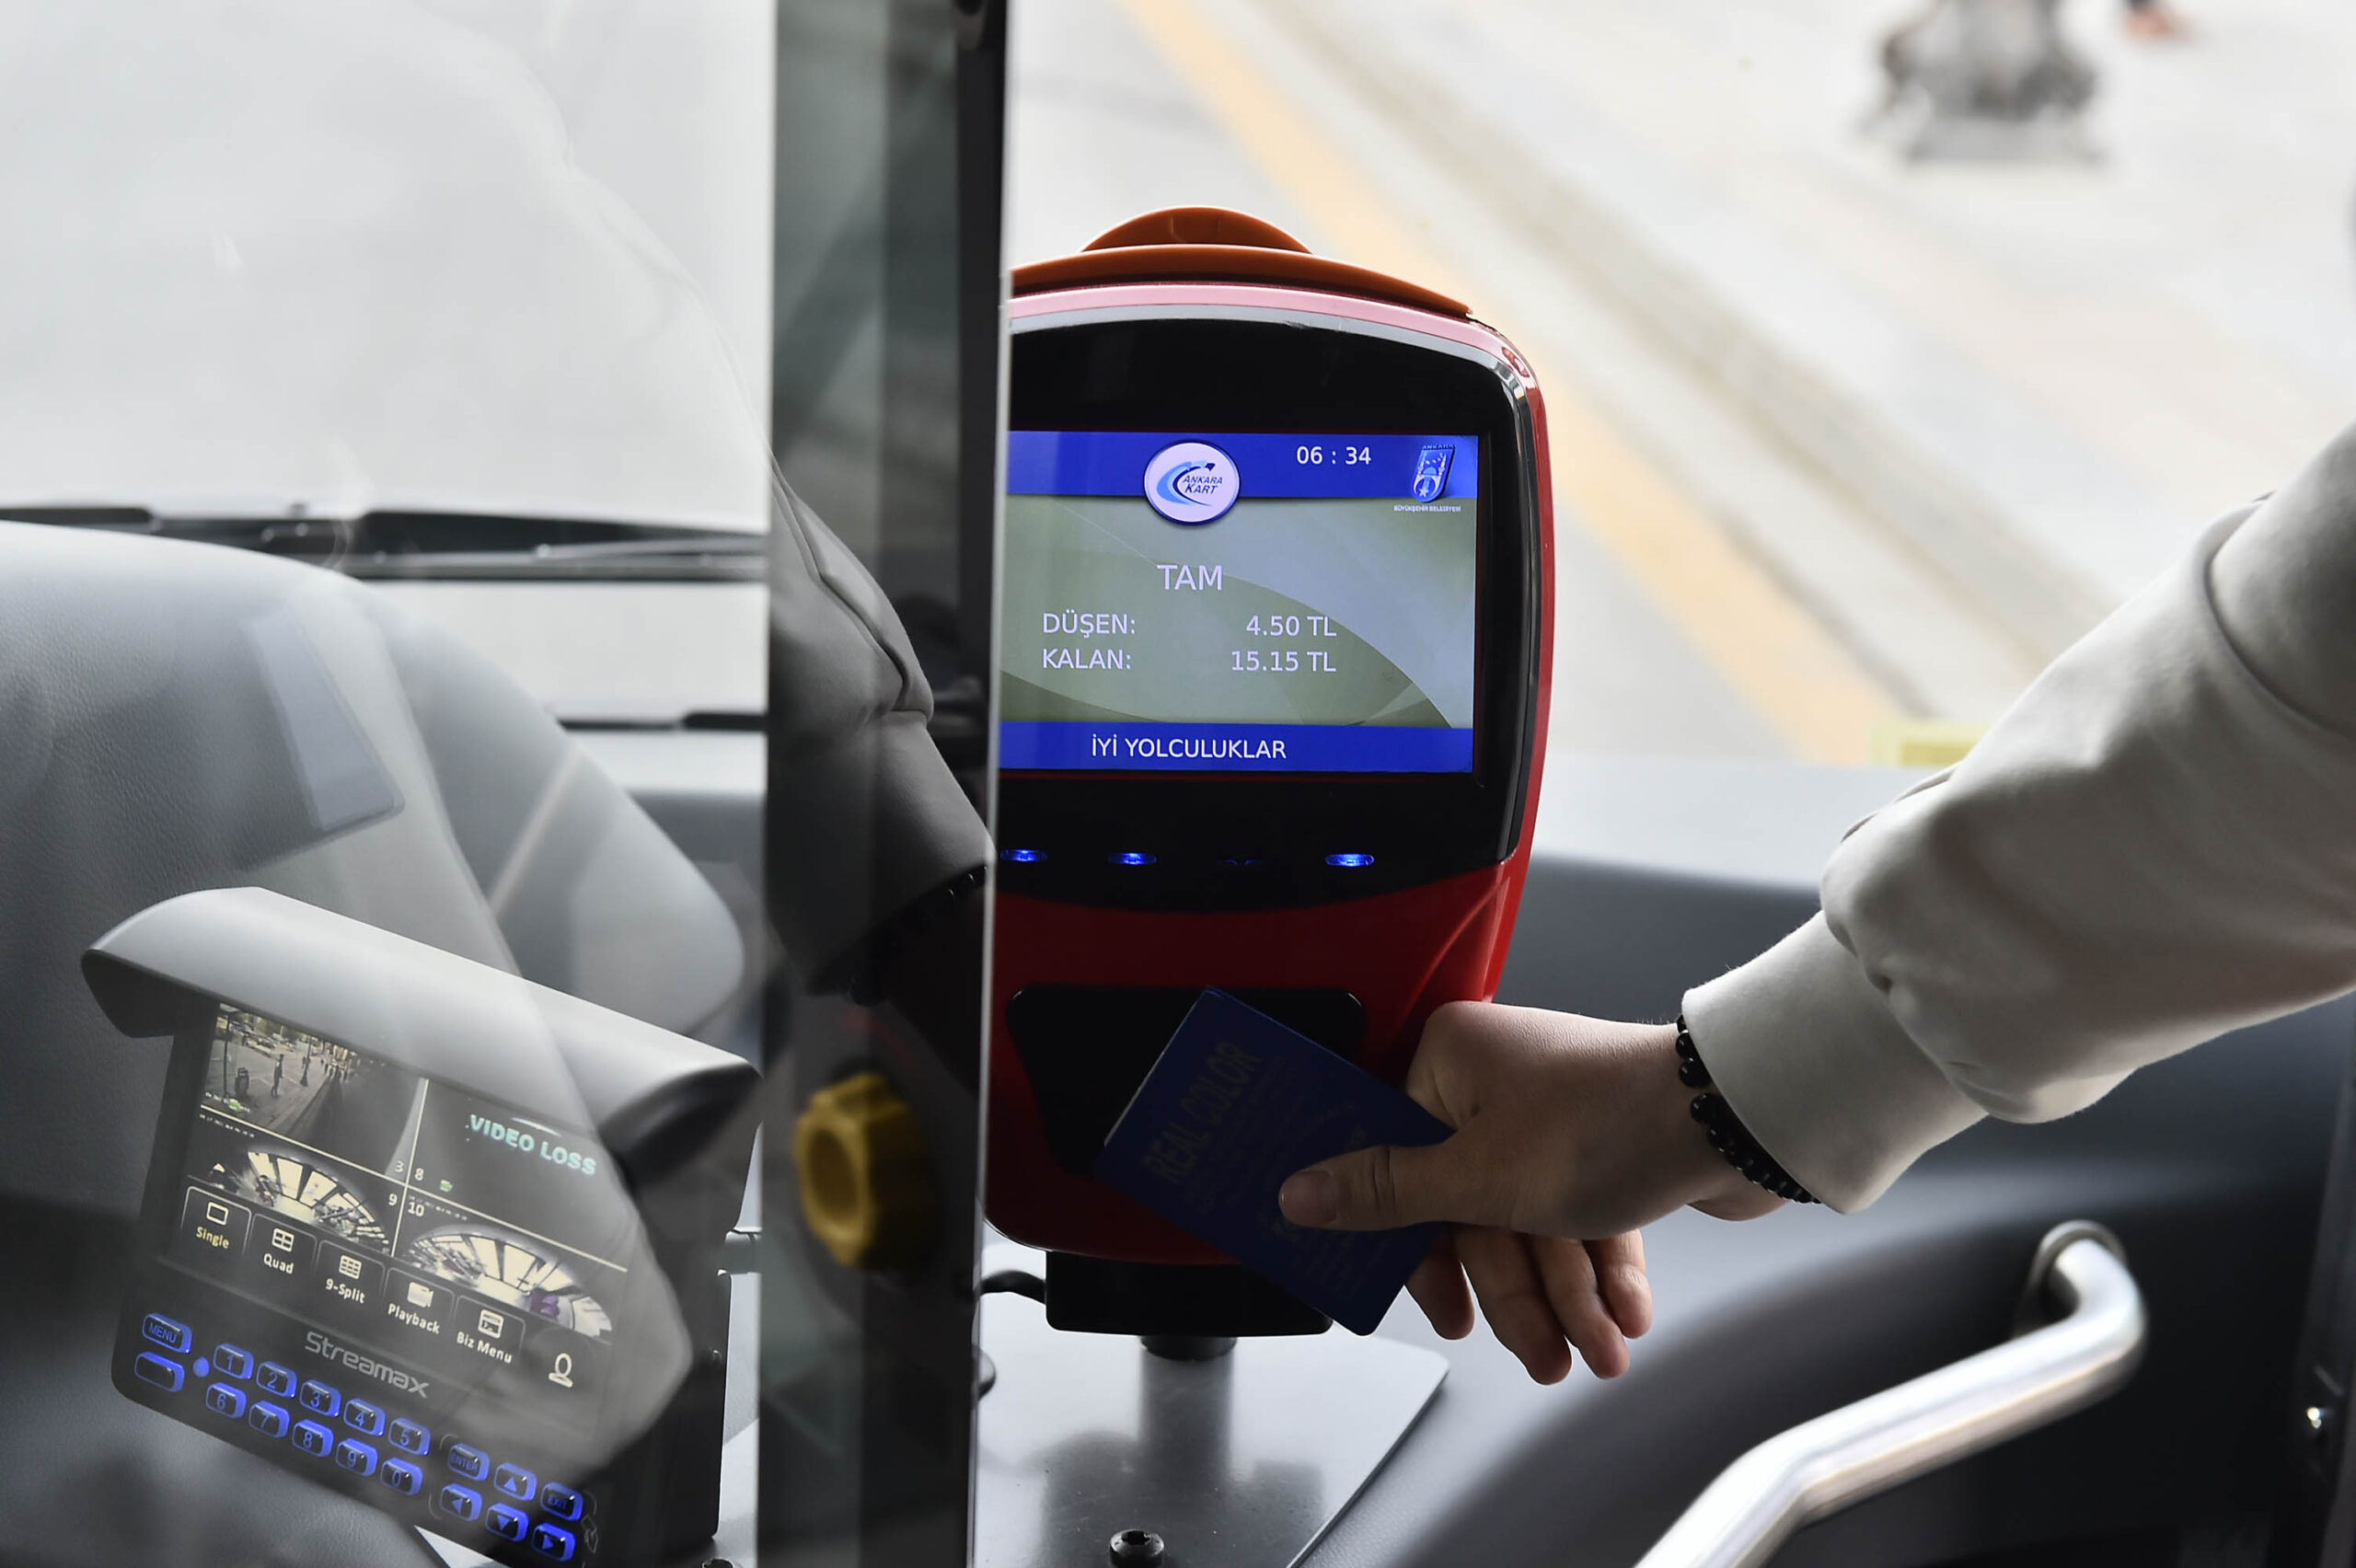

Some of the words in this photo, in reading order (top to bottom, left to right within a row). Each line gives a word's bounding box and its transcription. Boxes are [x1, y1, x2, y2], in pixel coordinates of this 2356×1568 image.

[1296, 446, 1322, 465] 06
[1345, 446, 1372, 465] 34
[1183, 475, 1222, 484] ANKARA
[1184, 484, 1218, 494] KART
[1157, 564, 1223, 591] TAM
[1042, 608, 1136, 639] DÜŞEN:
[1246, 616, 1300, 637] 4.50
[1307, 616, 1337, 637] TL
[1042, 649, 1132, 670] KALAN:
[1230, 651, 1299, 672] 15.15
[1307, 651, 1337, 673] TL
[1091, 733, 1117, 757] İYİ
[1125, 738, 1287, 760] YOLCULUKLAR
[1141, 1119, 1212, 1187] REAL
[1180, 1040, 1262, 1123] COLOR
[469, 1114, 536, 1153] VIDEO
[540, 1140, 597, 1177] LOSS
[395, 1160, 404, 1172] 3
[414, 1168, 424, 1182] 8
[387, 1193, 398, 1206] 9
[407, 1202, 425, 1216] 10
[195, 1225, 230, 1251] Single
[262, 1251, 295, 1275] Quad
[325, 1277, 366, 1305] 9-Split
[387, 1302, 441, 1335] Playback
[148, 1322, 178, 1343] MENU
[456, 1331, 475, 1349] Biz
[476, 1338, 514, 1365] Menu
[226, 1355, 234, 1371] 1
[305, 1331, 430, 1399] Streamax
[266, 1371, 278, 1389] 2
[216, 1393, 226, 1410] 6
[310, 1390, 322, 1409] 3
[259, 1412, 270, 1428] 7
[353, 1410, 365, 1427] 4
[302, 1430, 313, 1447] 8
[398, 1429, 410, 1446] 5
[347, 1449, 358, 1467] 9
[391, 1470, 401, 1487] 0
[547, 1494, 567, 1510] EXIT
